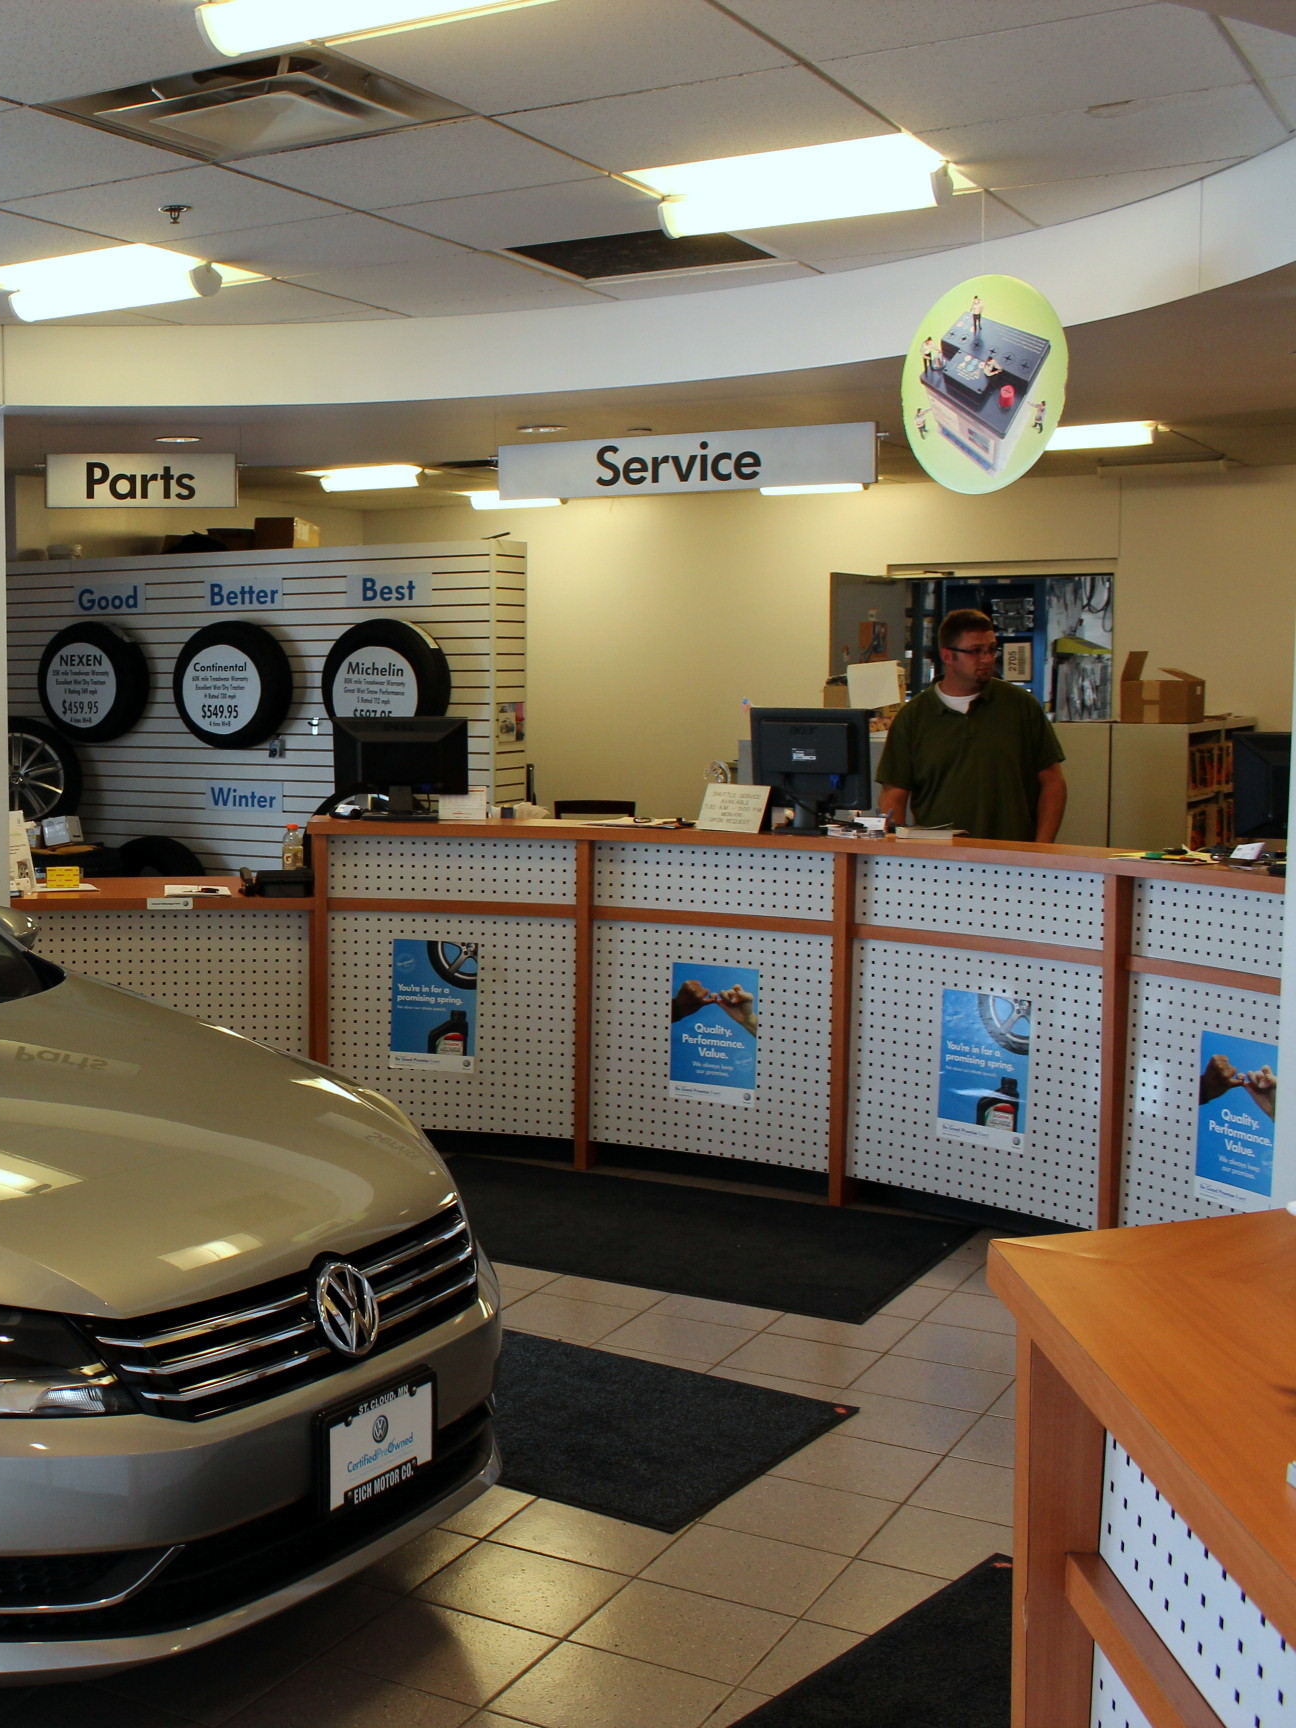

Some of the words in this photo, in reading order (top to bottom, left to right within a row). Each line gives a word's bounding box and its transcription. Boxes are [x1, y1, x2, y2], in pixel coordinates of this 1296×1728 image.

[596, 441, 762, 486] Service
[85, 461, 196, 500] Parts
[78, 586, 138, 611] Good
[210, 583, 278, 606] Better
[362, 577, 415, 602] Best
[60, 655, 102, 666] NEXEN
[194, 662, 247, 672] Continental
[347, 662, 403, 676] Michelin
[1008, 651, 1016, 672] 2705
[62, 700, 98, 716] $459.95
[202, 704, 239, 719] $549.95
[353, 709, 392, 718] $59795
[210, 787, 276, 809] Winter
[398, 984, 420, 993] You're
[422, 985, 429, 993] in
[431, 985, 442, 993] for
[397, 995, 435, 1004] promising
[437, 997, 463, 1006] spring.
[695, 1023, 732, 1036] Quality.
[682, 1034, 745, 1049] Performance.
[946, 1040, 970, 1053] You're
[972, 1044, 979, 1053] in
[981, 1045, 993, 1056] for
[994, 1050, 1001, 1058] a
[698, 1047, 728, 1059] Value.
[703, 1062, 720, 1070] always
[946, 1053, 985, 1068] promising
[987, 1060, 1014, 1072] spring.
[1221, 1109, 1259, 1130] Quality.
[1209, 1120, 1273, 1146] Performance.
[1225, 1139, 1255, 1157] Value.
[359, 1404, 370, 1415] ST.
[398, 1384, 408, 1396] MN
[354, 1482, 372, 1504] EICH
[374, 1468, 400, 1498] MOTOR
[402, 1464, 414, 1480] CO.
